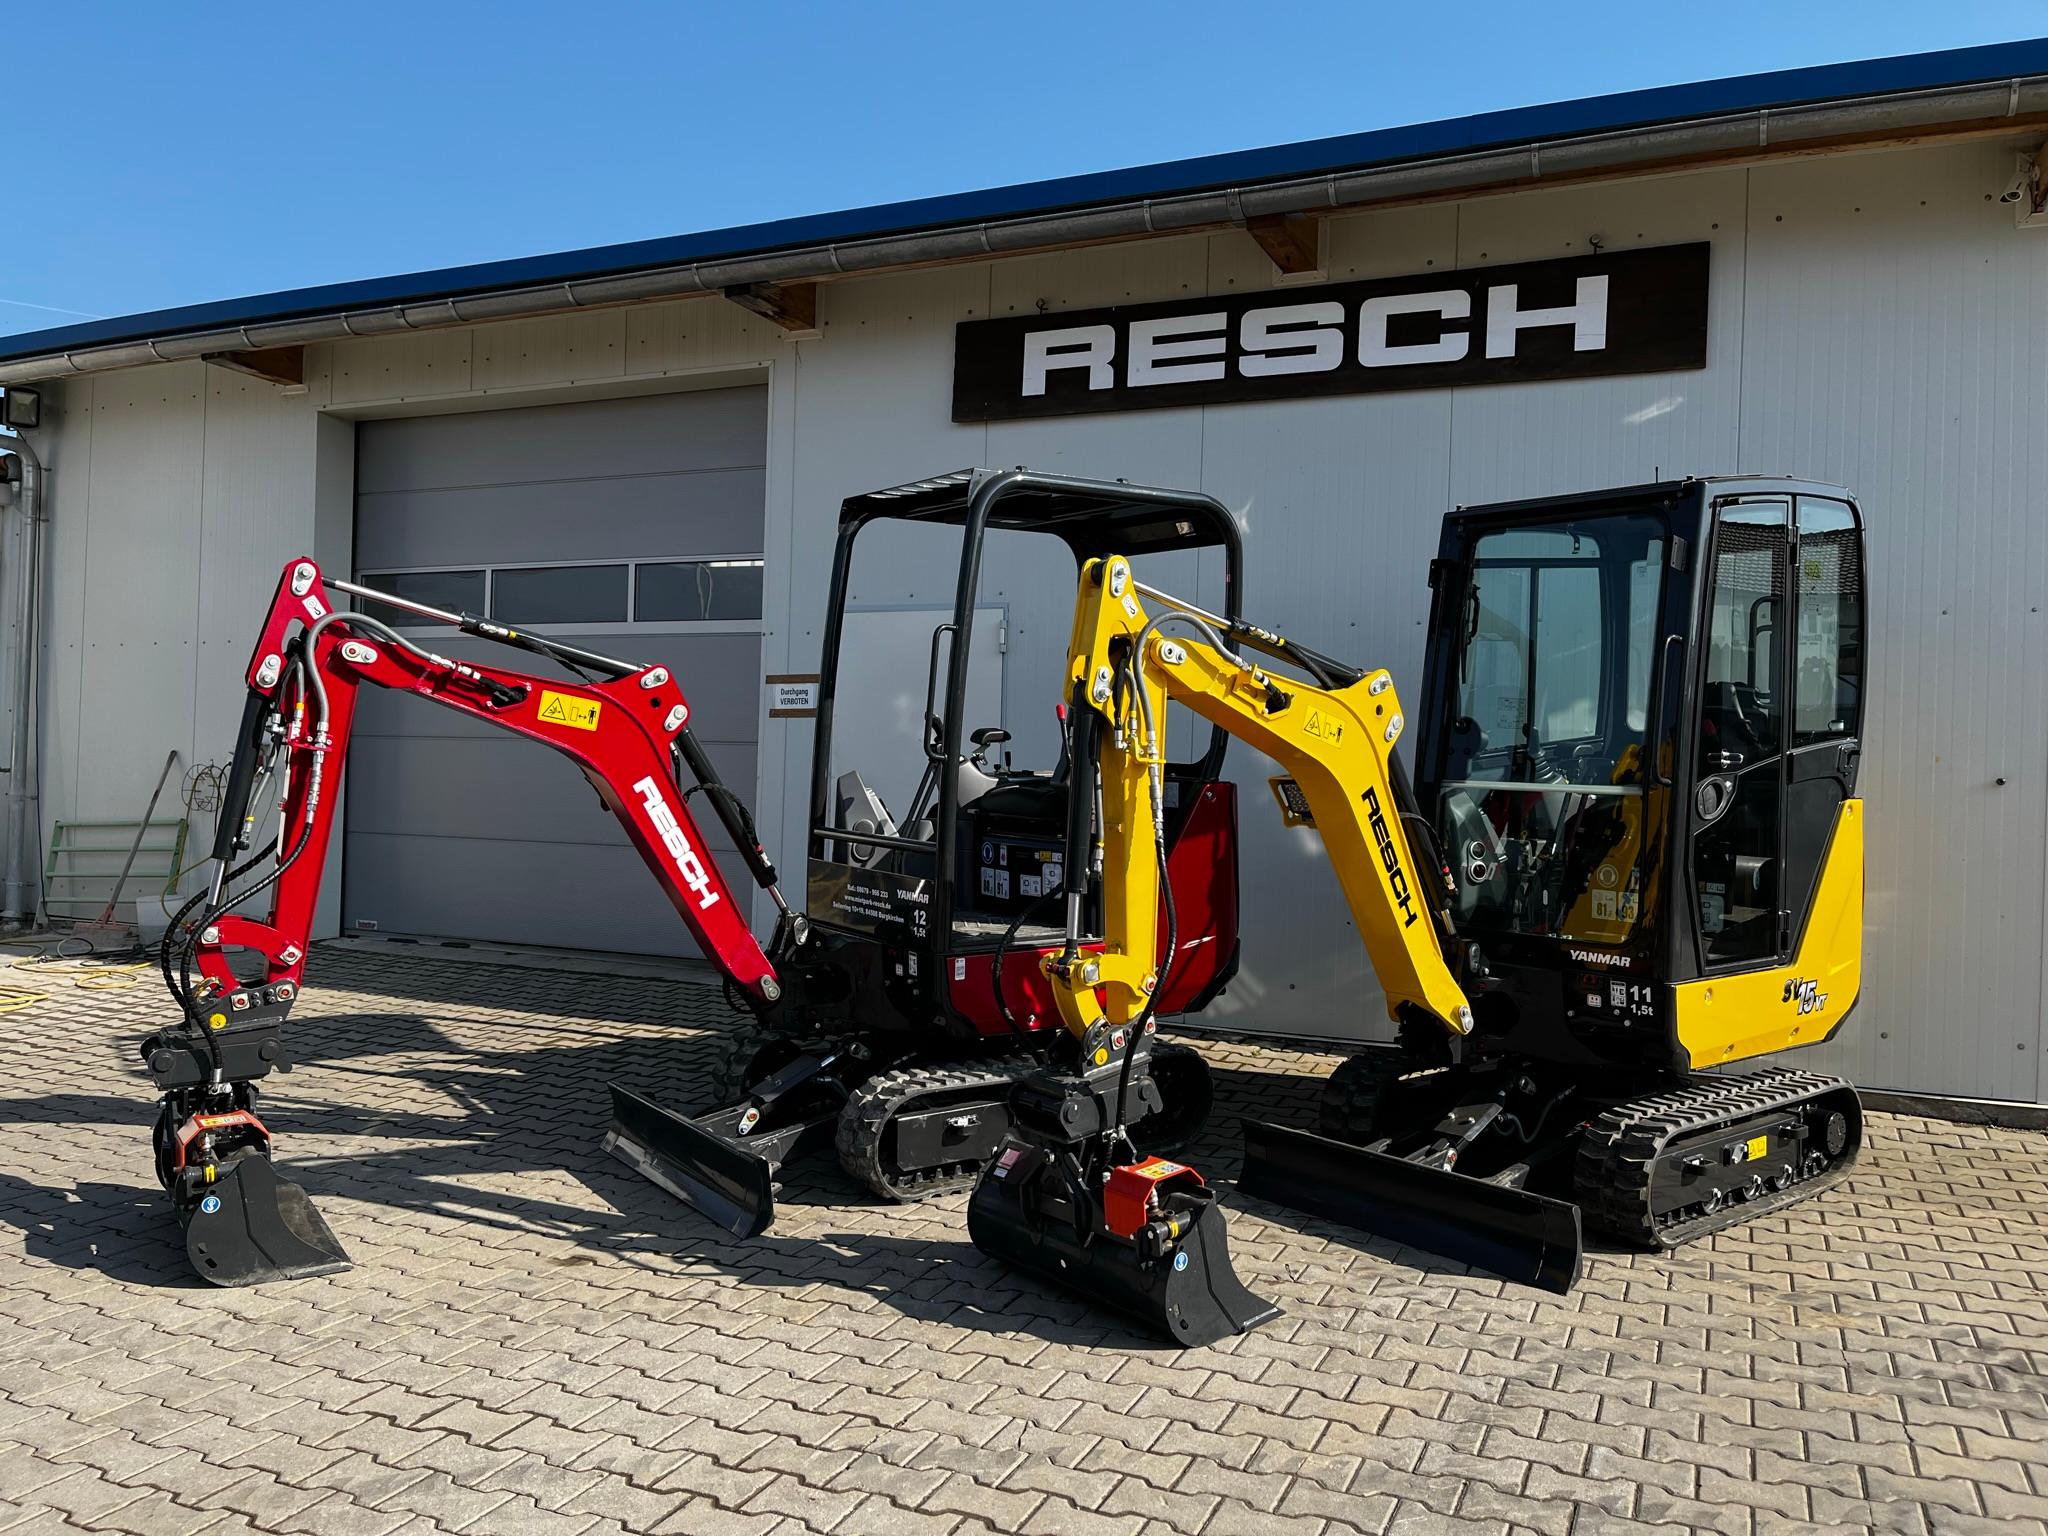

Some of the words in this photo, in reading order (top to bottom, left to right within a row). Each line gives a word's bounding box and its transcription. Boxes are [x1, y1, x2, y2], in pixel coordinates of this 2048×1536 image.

[1022, 274, 1609, 397] RESCH
[780, 687, 809, 697] Durchgang
[780, 697, 809, 705] VERBOTEN
[632, 775, 720, 910] RESCH
[1361, 785, 1418, 928] RESCH
[896, 888, 929, 904] YANMAR
[878, 911, 905, 923] Burgkirchen
[913, 908, 927, 925] 12
[913, 926, 927, 938] 1,5t
[1569, 949, 1632, 968] YANMAR
[1629, 985, 1652, 1003] 11
[1630, 1003, 1654, 1017] 1,5t
